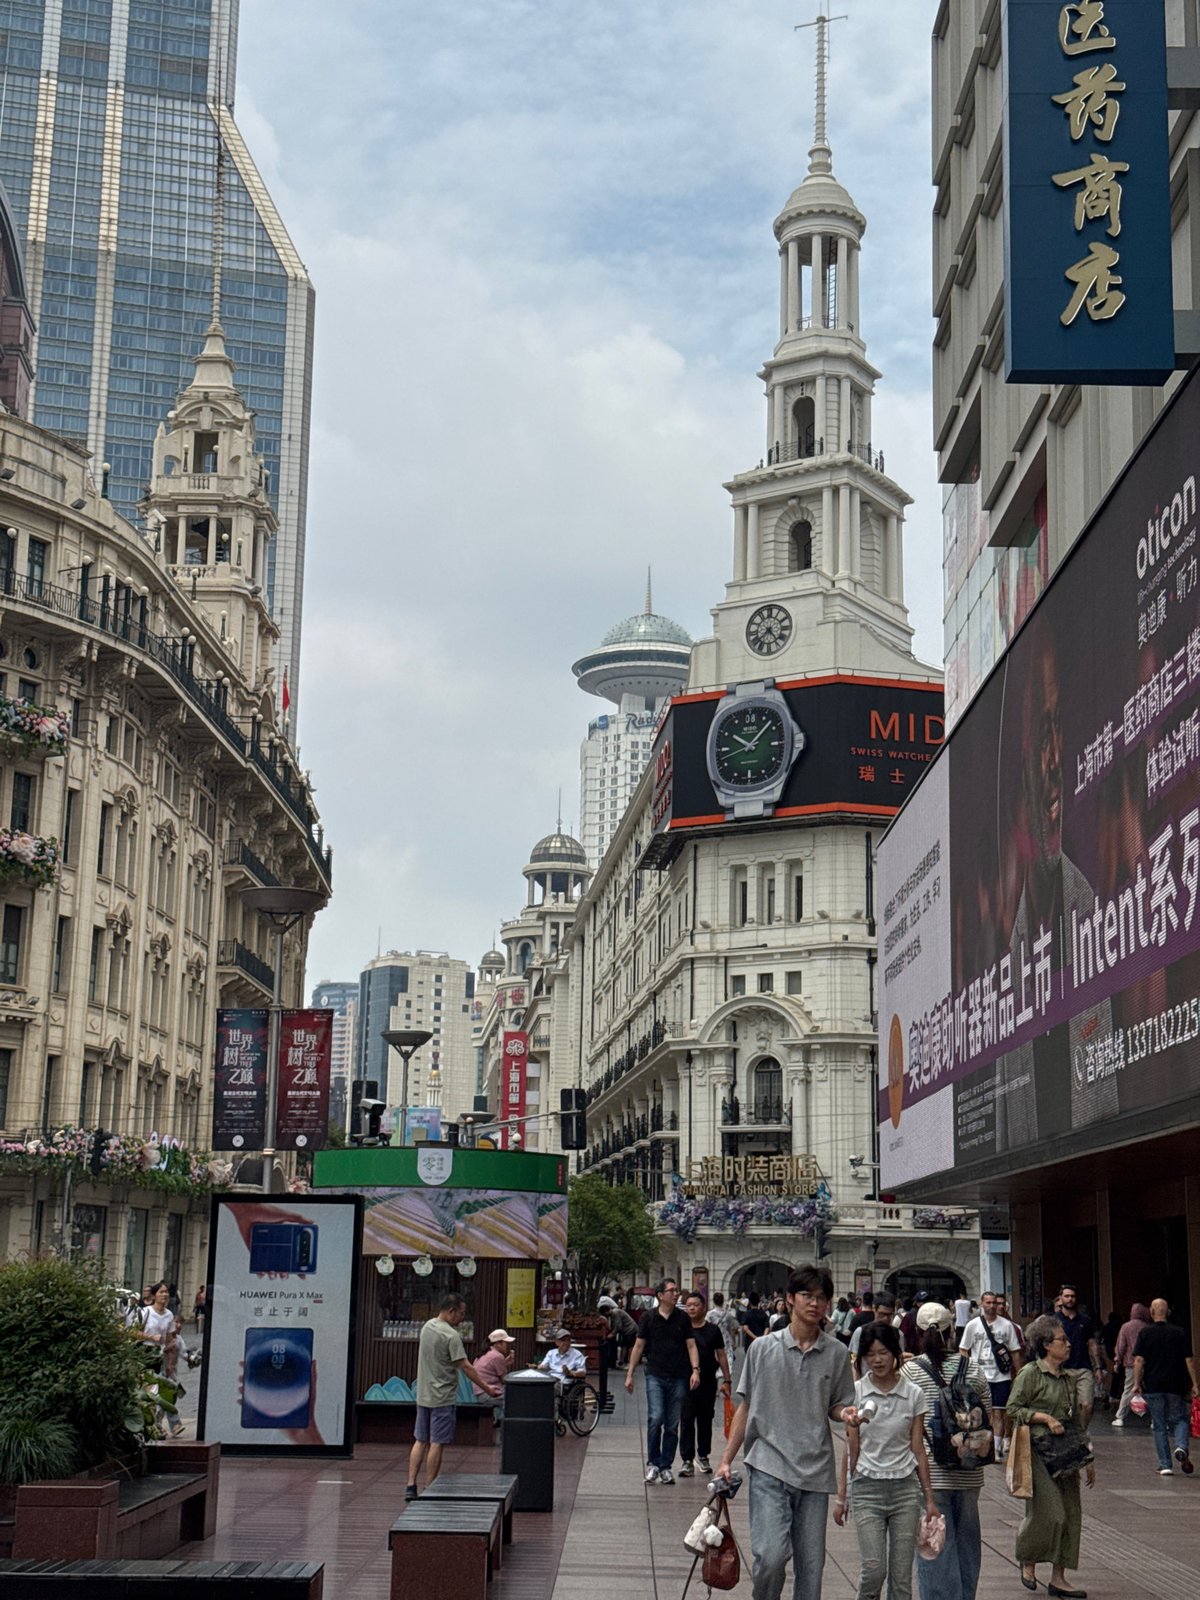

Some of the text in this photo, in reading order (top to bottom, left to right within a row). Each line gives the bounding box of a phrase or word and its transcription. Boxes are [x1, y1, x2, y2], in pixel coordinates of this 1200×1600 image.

[1051, 0, 1130, 326] 医药商店
[1136, 475, 1196, 580] oticon
[850, 746, 883, 757] SWISS
[908, 923, 1052, 1095] 奥迪康助听器新品上市
[682, 1154, 816, 1182] 上海时装商店
[680, 1184, 817, 1195] SHANGHAI FASHION STORE
[240, 1291, 324, 1300] HUAWEI Pura X Max
[272, 1343, 286, 1354] 08
[271, 1354, 286, 1364] 08
